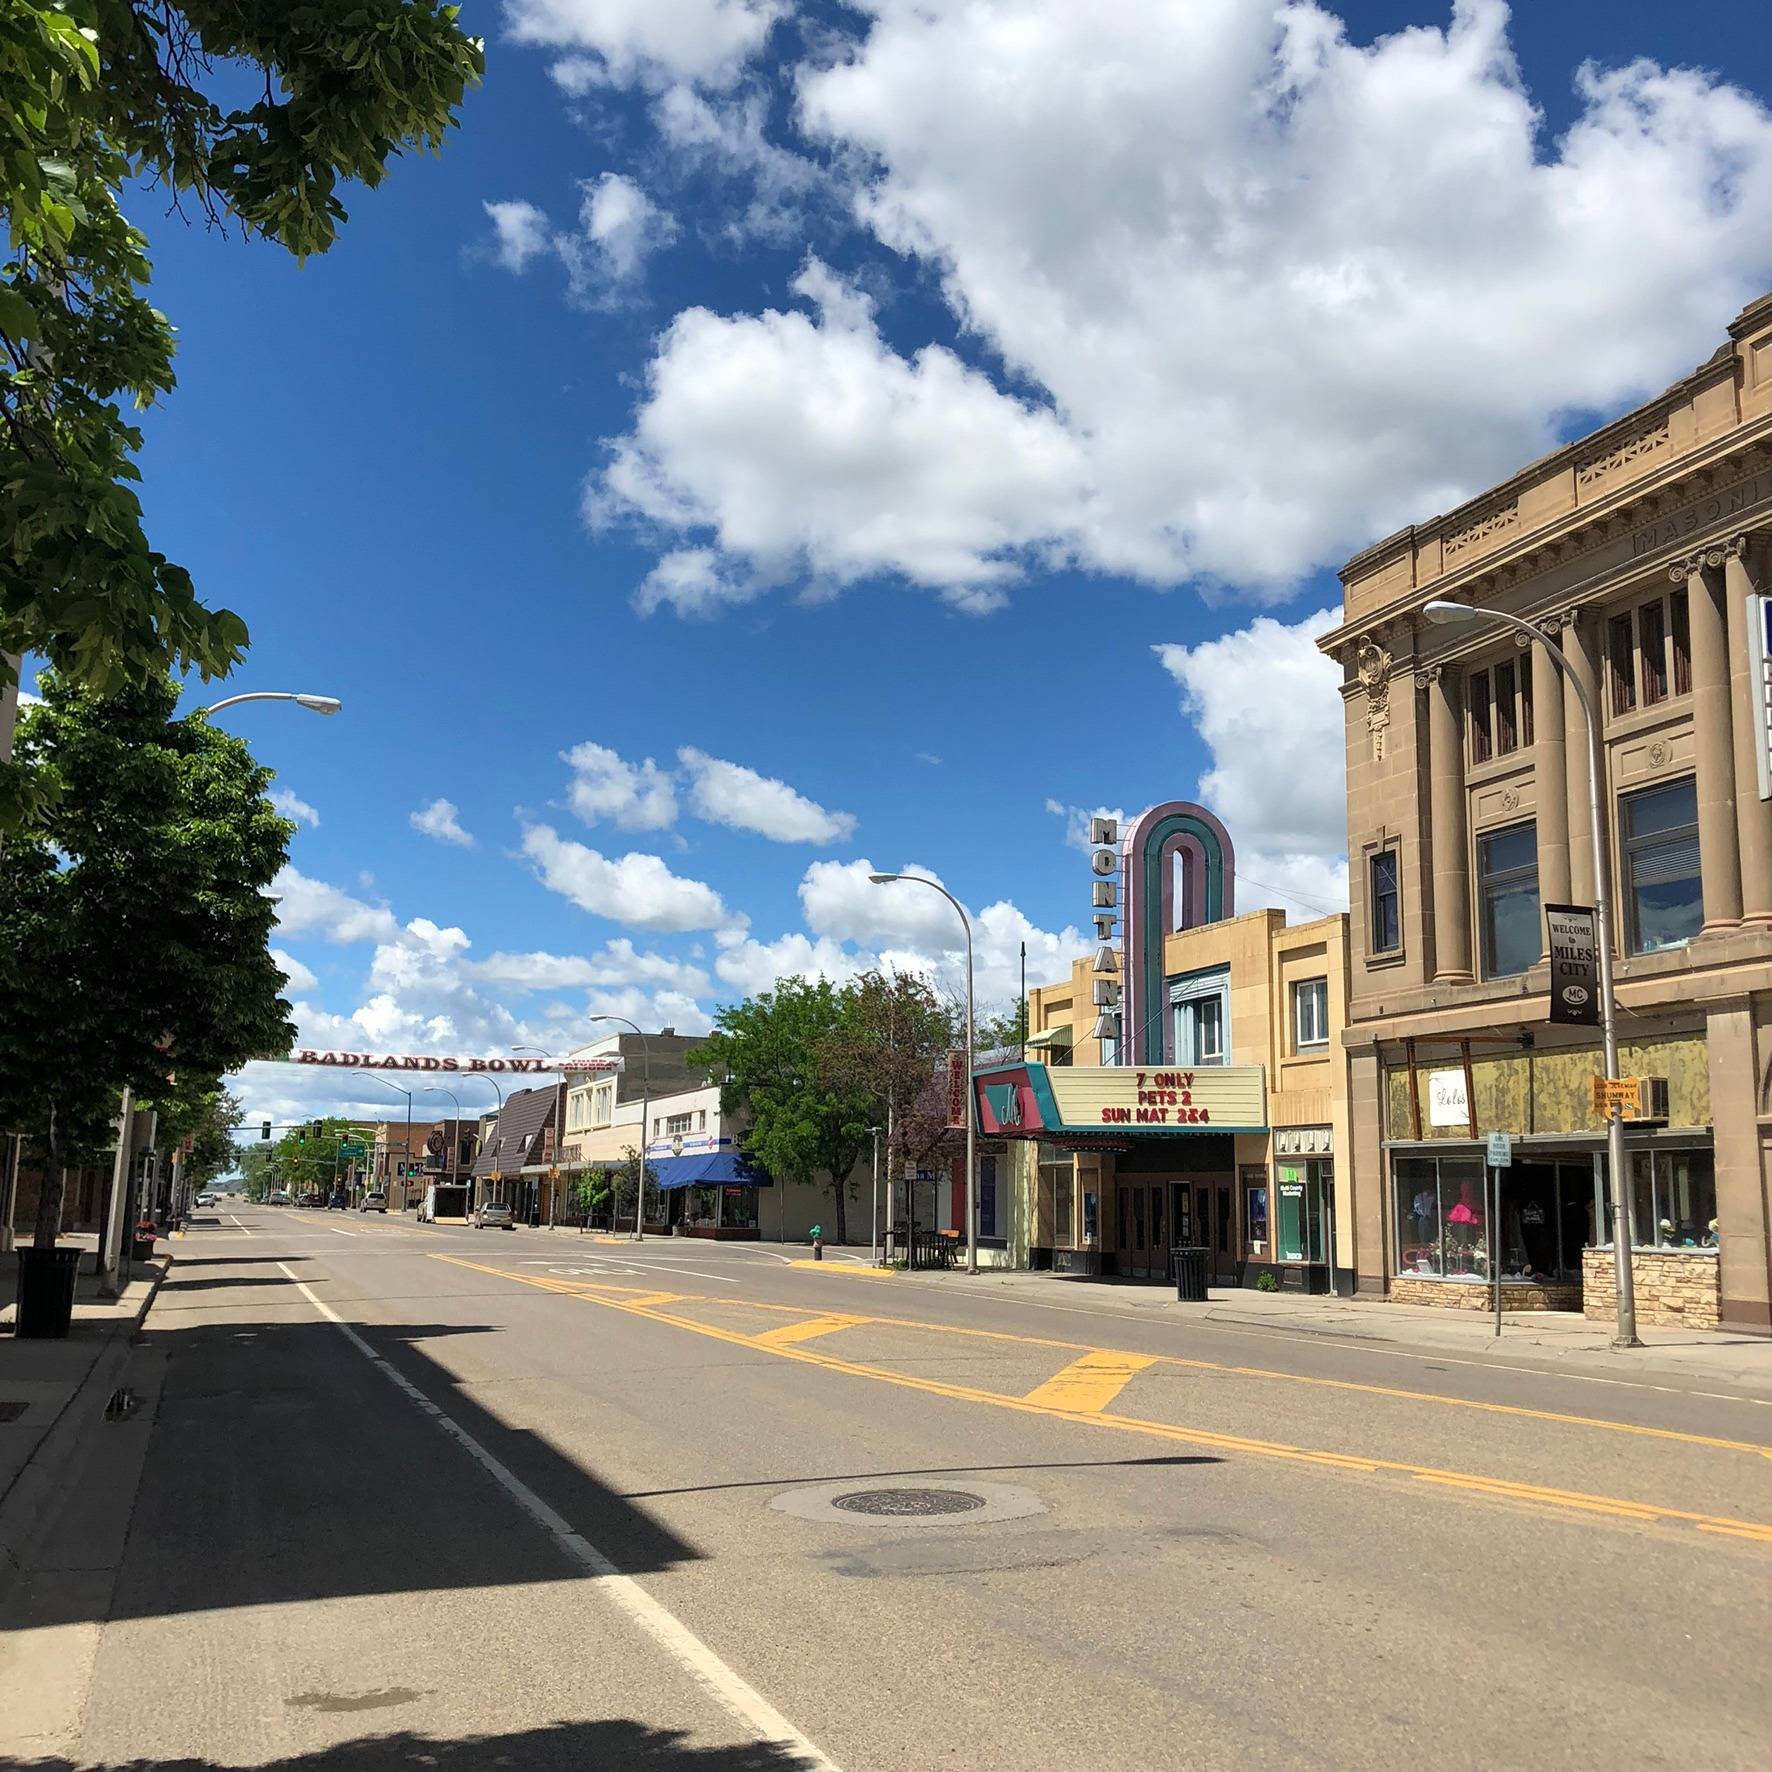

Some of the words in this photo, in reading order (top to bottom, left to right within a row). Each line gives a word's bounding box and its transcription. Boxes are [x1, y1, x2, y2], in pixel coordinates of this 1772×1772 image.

[1632, 478, 1772, 556] MASONI
[1090, 818, 1118, 1039] MONTANA
[1552, 924, 1592, 936] WELCOME
[1554, 946, 1593, 961] MILES
[1560, 962, 1589, 976] CITY
[1568, 988, 1583, 999] MC
[298, 1050, 459, 1071] BADLANDS
[468, 1058, 552, 1073] BOWL
[1136, 1072, 1146, 1089] 7
[1154, 1072, 1194, 1089] ONLY
[951, 1061, 963, 1124] WELCOME
[1138, 1090, 1178, 1106] PETS
[1181, 1090, 1192, 1106] 2
[1596, 1091, 1635, 1100] SHUMWAY
[1101, 1108, 1131, 1123] SUN
[1136, 1108, 1168, 1123] MAT
